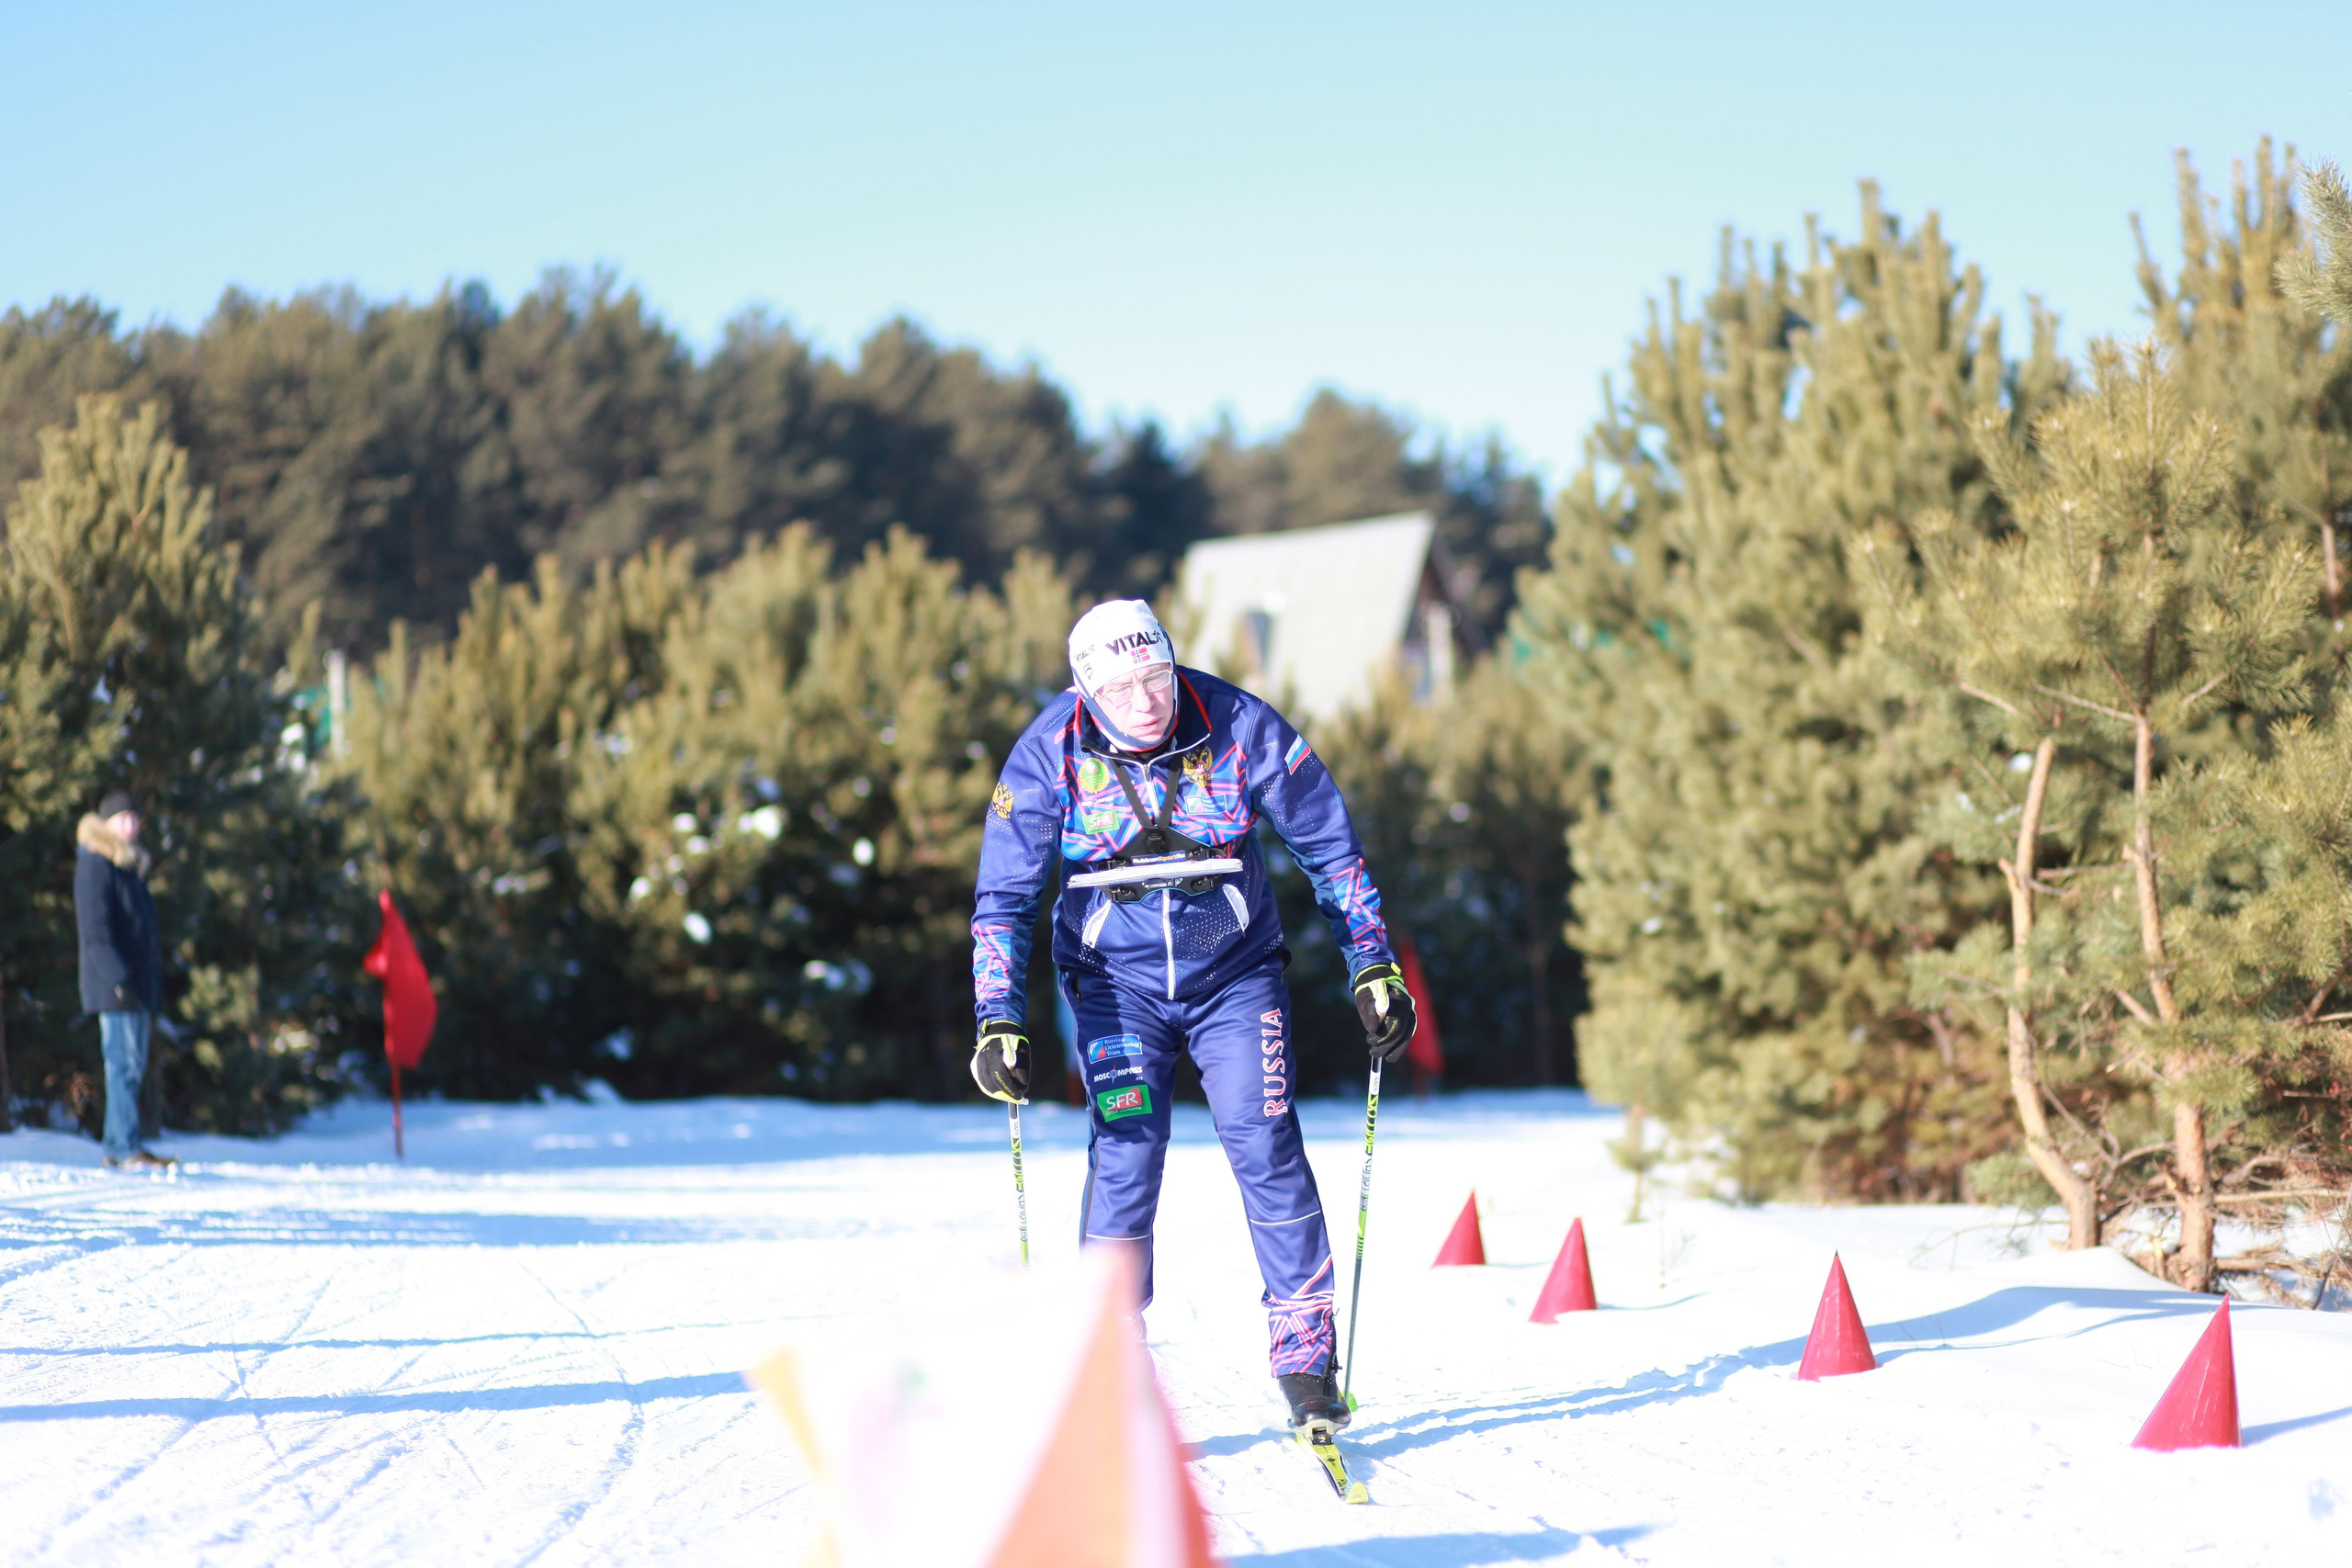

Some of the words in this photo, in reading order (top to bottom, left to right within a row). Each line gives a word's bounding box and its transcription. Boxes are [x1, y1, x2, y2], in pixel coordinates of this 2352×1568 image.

[1105, 631, 1157, 655] VITAL
[1089, 814, 1112, 827] SFR
[1261, 1008, 1288, 1117] RUSSIA
[1106, 1092, 1139, 1111] SFR
